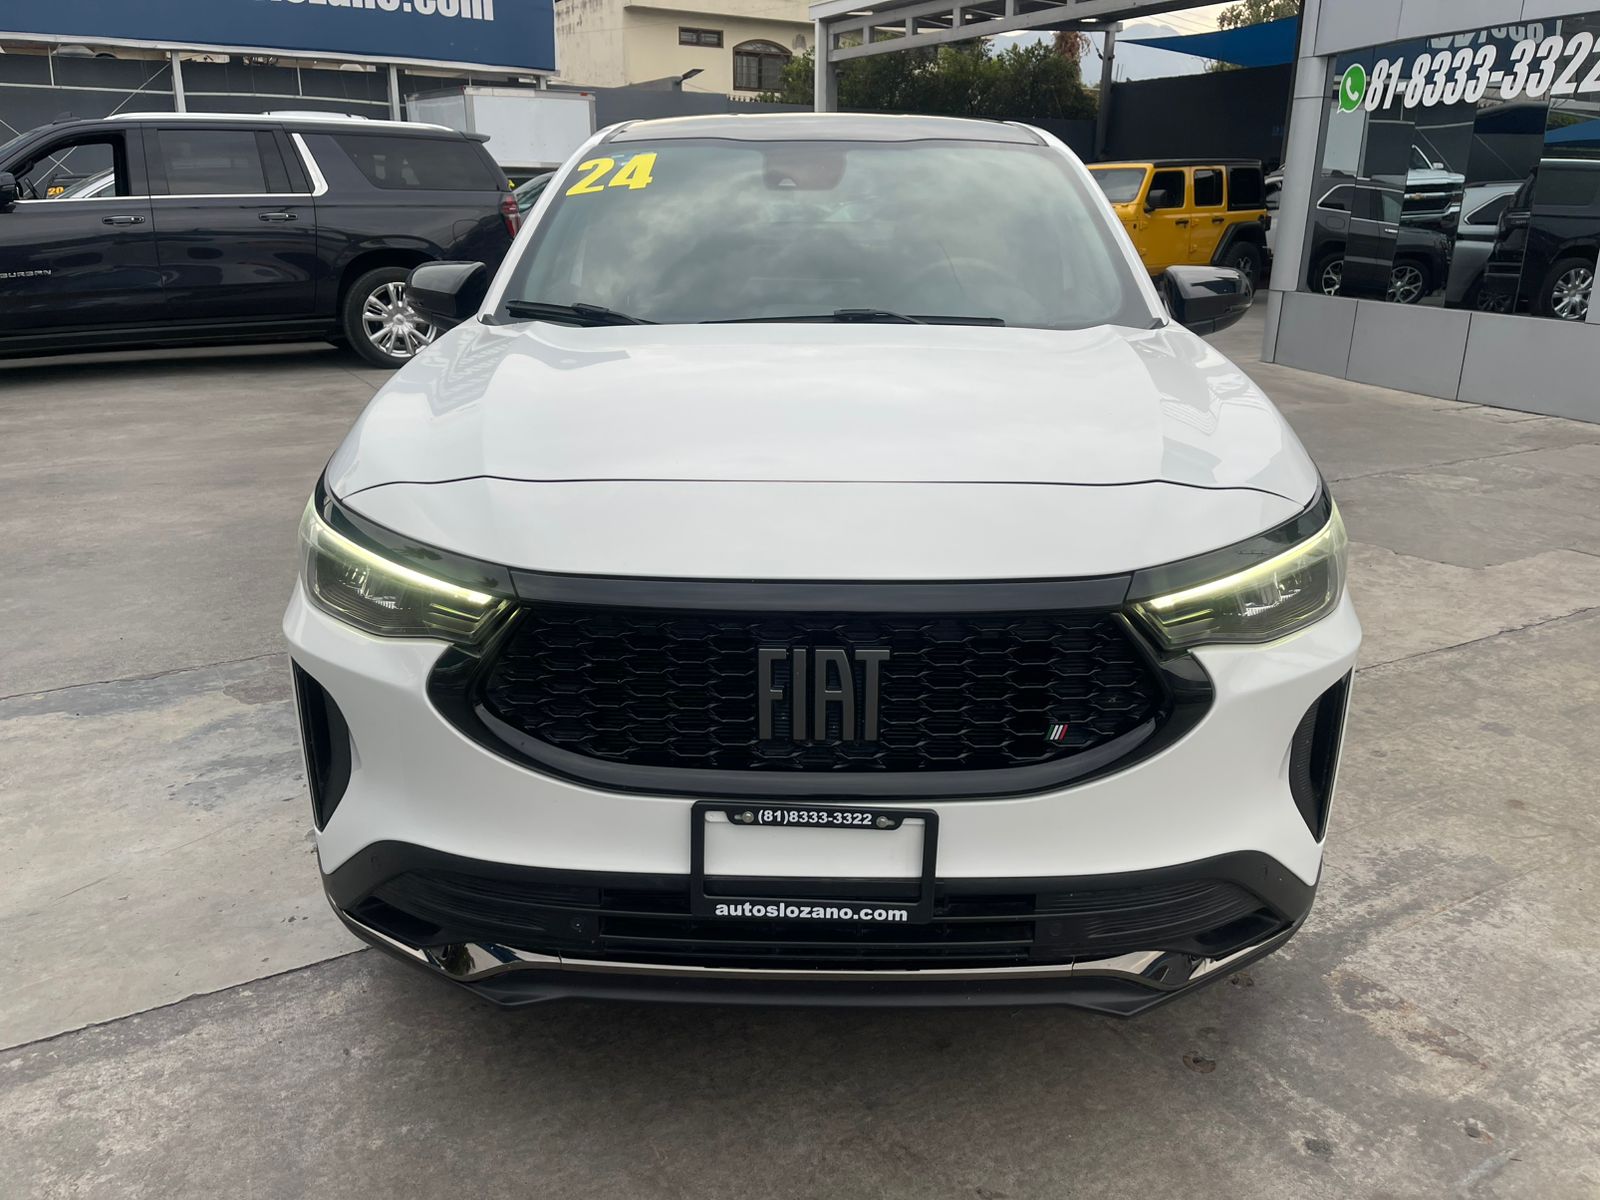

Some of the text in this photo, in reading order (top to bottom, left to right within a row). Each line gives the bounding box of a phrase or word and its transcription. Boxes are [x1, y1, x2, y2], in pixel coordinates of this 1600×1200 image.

[566, 152, 657, 196] 24
[758, 649, 890, 739] FIAT
[757, 809, 873, 827] (81)8333-3322
[715, 902, 908, 922] autoslozano.com
